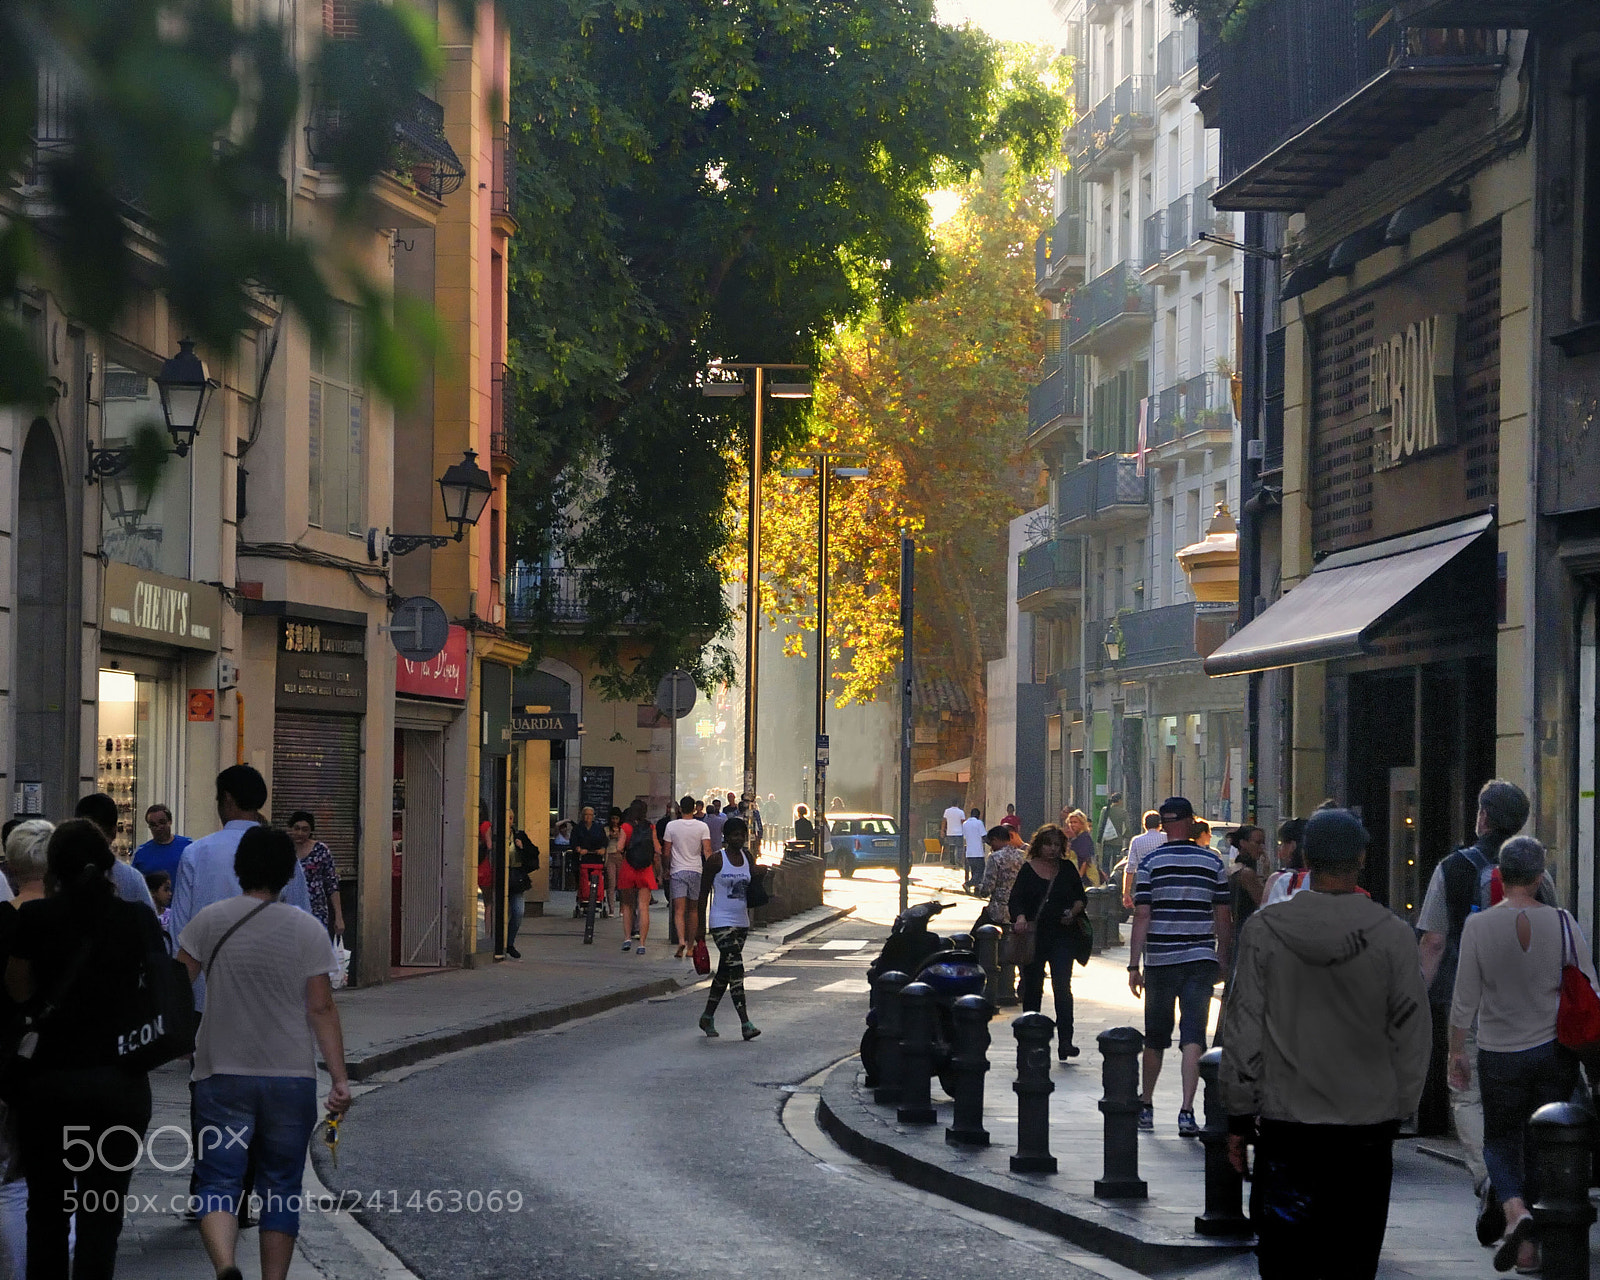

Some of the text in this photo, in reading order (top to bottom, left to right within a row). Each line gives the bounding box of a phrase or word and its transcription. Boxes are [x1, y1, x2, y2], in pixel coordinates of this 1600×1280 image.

[1390, 314, 1438, 461] BOIX
[134, 581, 188, 636] CHENY'S
[509, 717, 563, 730] UARDIA
